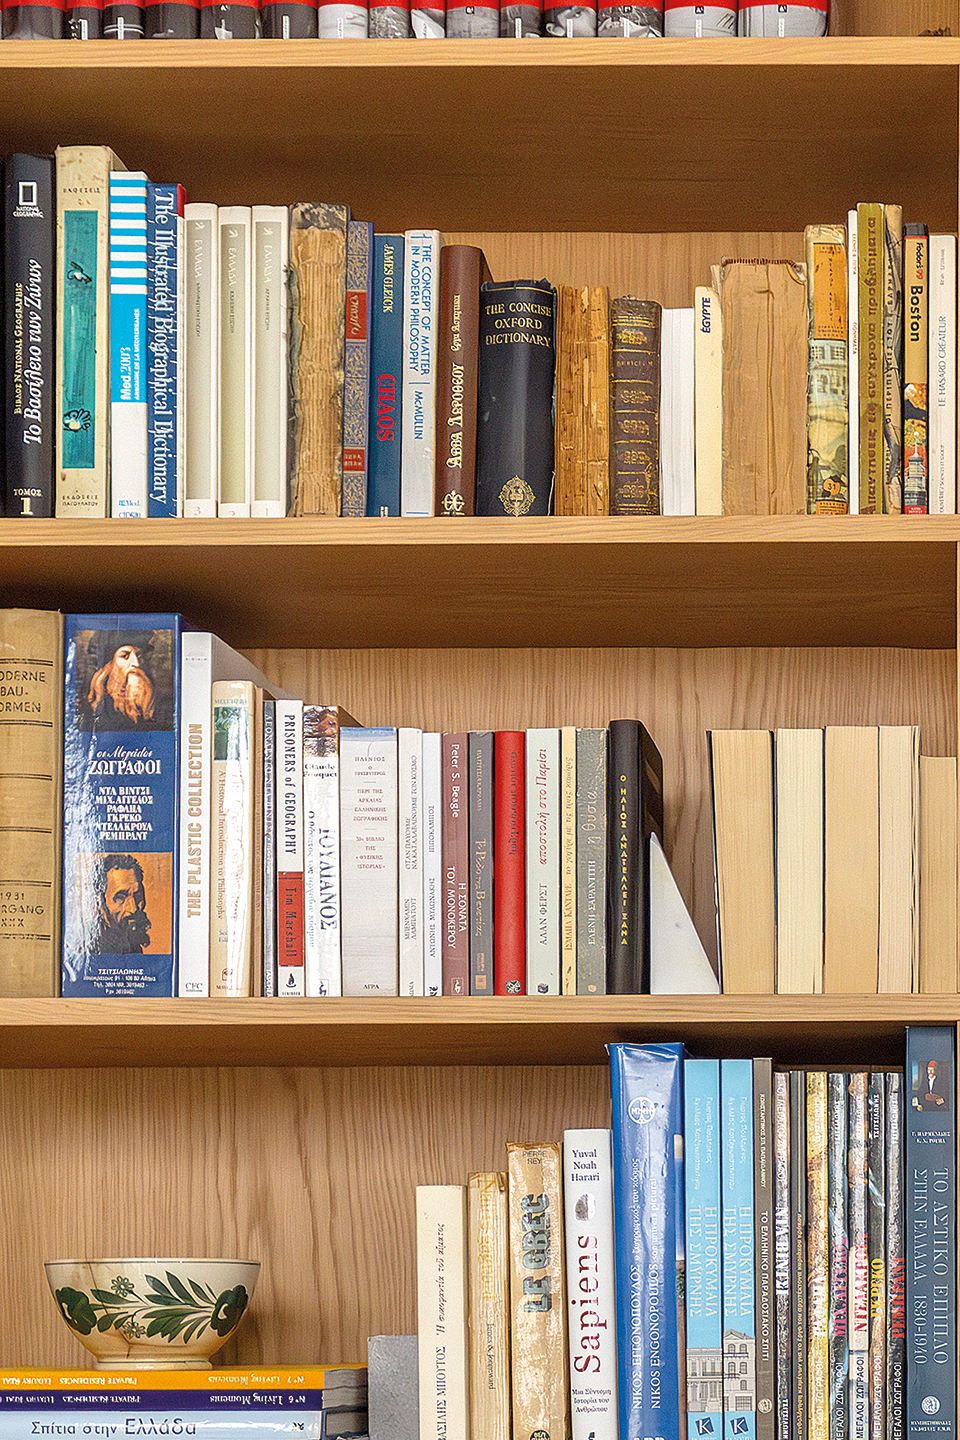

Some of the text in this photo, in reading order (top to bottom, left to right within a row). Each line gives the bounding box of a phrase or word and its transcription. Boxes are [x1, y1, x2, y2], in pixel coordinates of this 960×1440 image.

[383, 244, 393, 313] JAMES GLEICK
[14, 282, 23, 337] GEOGRAPHIC
[409, 246, 420, 371] IN MODERN PHILOSOPHY
[420, 245, 431, 375] THE CONCEPT OF MATTER
[485, 302, 551, 317] THE CONCISE
[494, 317, 542, 329] OXFORD
[699, 297, 711, 333] ÉGYPTE
[910, 285, 923, 342] Boston
[14, 338, 22, 382] NATIONAL
[152, 192, 175, 504] The Illustrated Biographical Dictionary
[485, 332, 550, 348] DICTIONARY
[23, 424, 41, 444] Το
[377, 374, 396, 441] CHAOS
[413, 391, 423, 440] McMULLIN
[88, 760, 161, 775] ΖΩΓΡΑΦΟΙ
[284, 715, 296, 854] PRISONERS of GEOGRAPHY
[450, 744, 460, 818] Peter S. Beagle
[188, 723, 202, 918] THE PLASTIC COLLECTION
[535, 748, 550, 865] αποστολή στο Παρίσι
[285, 887, 297, 957] Tim Marshall
[447, 866, 455, 949] ΤΟΥ ΜΟΝΟΚΕΡΟΥ
[539, 883, 547, 945] ΑΛΑΝ ΦΕΡΣΤ
[571, 1172, 600, 1181] Harari
[572, 1149, 597, 1158] Yuval
[573, 1161, 597, 1169] Noah
[762, 1210, 769, 1223] ΤΟ
[914, 1169, 927, 1212] ΣΤΗΝ
[933, 1168, 948, 1364] ΤΟ ΑΣΤΙΚΟ ΕΠΙΠΛΟ
[571, 1235, 607, 1373] Sapiens
[914, 1294, 927, 1364] 1830-1940
[649, 1264, 660, 1409] NIKOS ENGONOPOULOS
[31, 1417, 196, 1437] Σπίτια στην Ελλάδα
